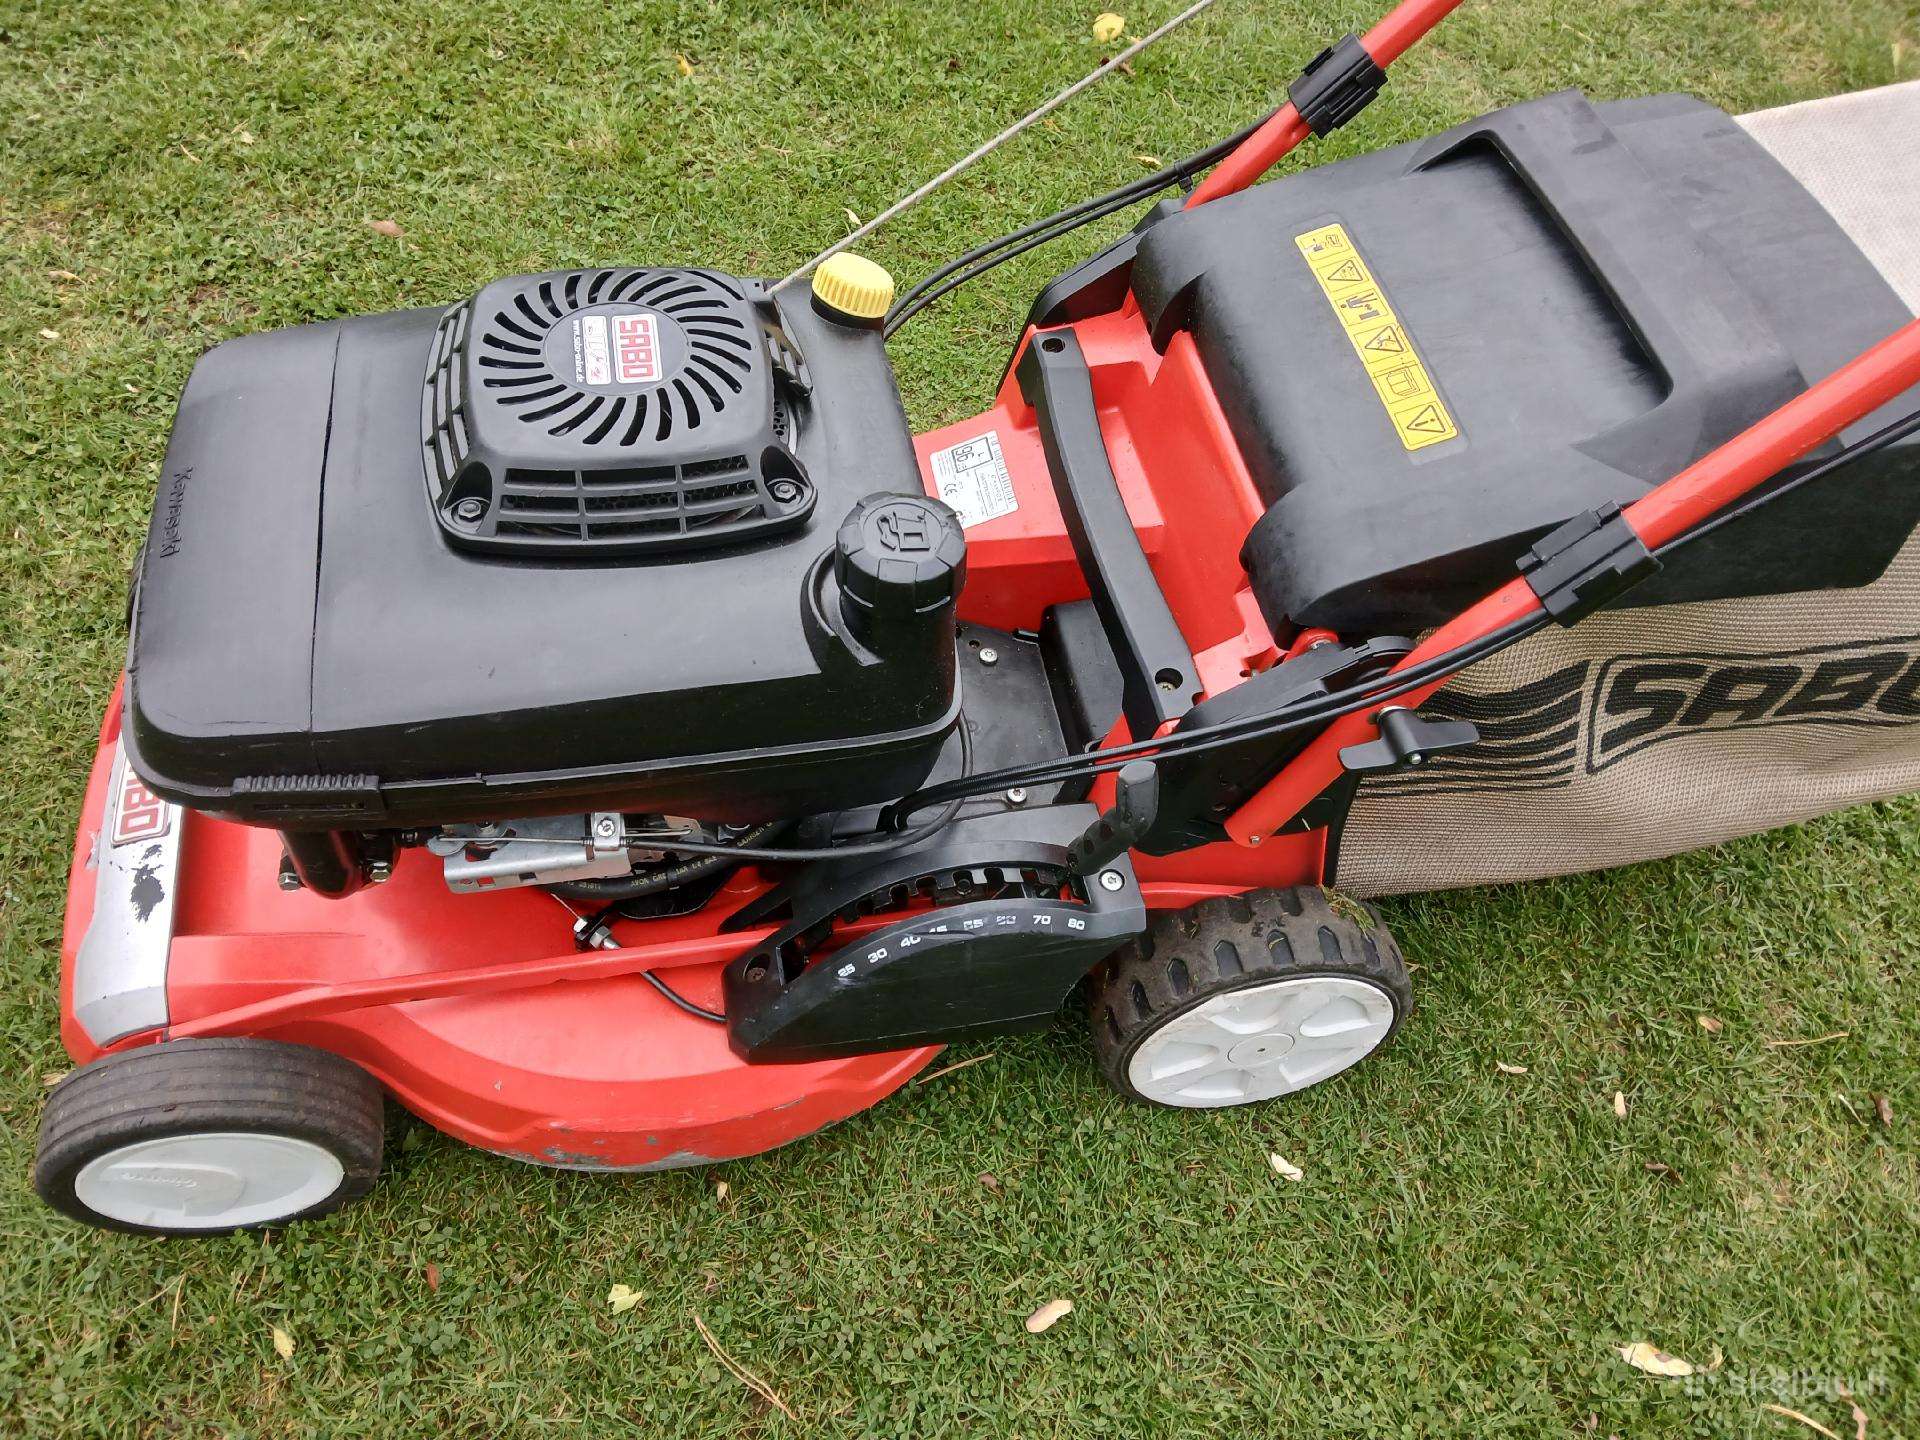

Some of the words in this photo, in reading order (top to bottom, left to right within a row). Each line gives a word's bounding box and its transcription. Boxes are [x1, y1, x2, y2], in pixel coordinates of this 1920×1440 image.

[619, 319, 654, 378] SABO
[119, 765, 159, 836] BO
[837, 963, 856, 978] 25
[867, 947, 888, 964] 30
[1032, 914, 1051, 926] 70
[1067, 917, 1086, 931] 80
